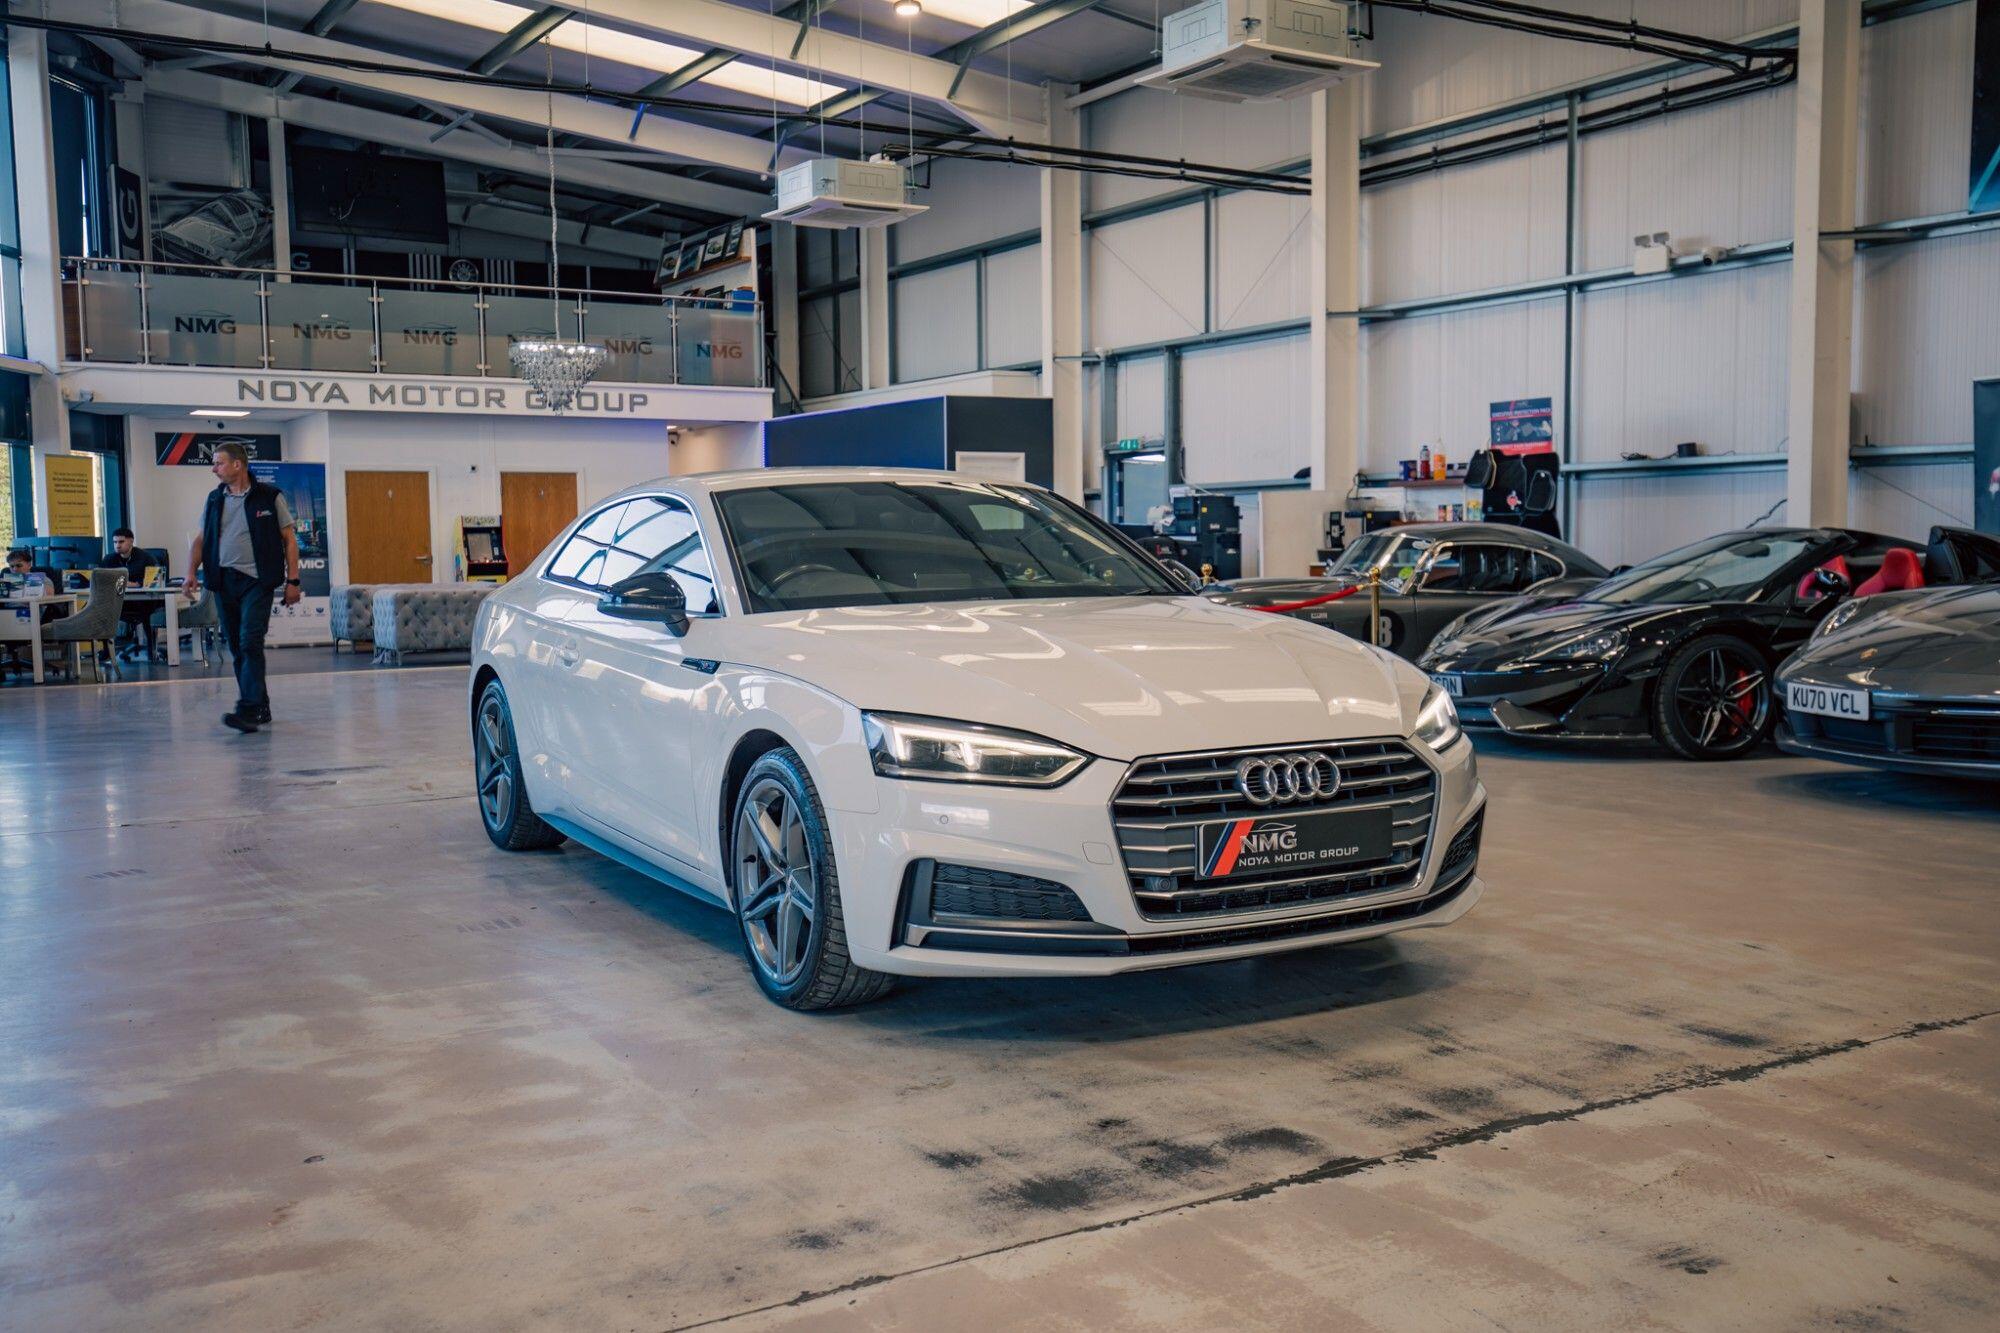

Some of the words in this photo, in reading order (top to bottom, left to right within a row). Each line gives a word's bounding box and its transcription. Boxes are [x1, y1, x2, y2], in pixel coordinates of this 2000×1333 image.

[174, 316, 236, 335] NMG
[293, 323, 352, 341] NMG
[402, 329, 459, 346] NMG
[696, 343, 743, 360] NMG
[238, 379, 350, 404] NOYA
[369, 383, 506, 409] MOTOR
[525, 389, 648, 412] GOUP
[198, 443, 258, 459] NG
[297, 559, 325, 569] MIC
[1791, 685, 1827, 711] KU70
[1829, 692, 1861, 715] VCL
[1239, 830, 1297, 855] NMG
[1238, 856, 1270, 867] NOYA
[1274, 850, 1315, 863] MOTOR
[1320, 846, 1360, 858] GROUP
